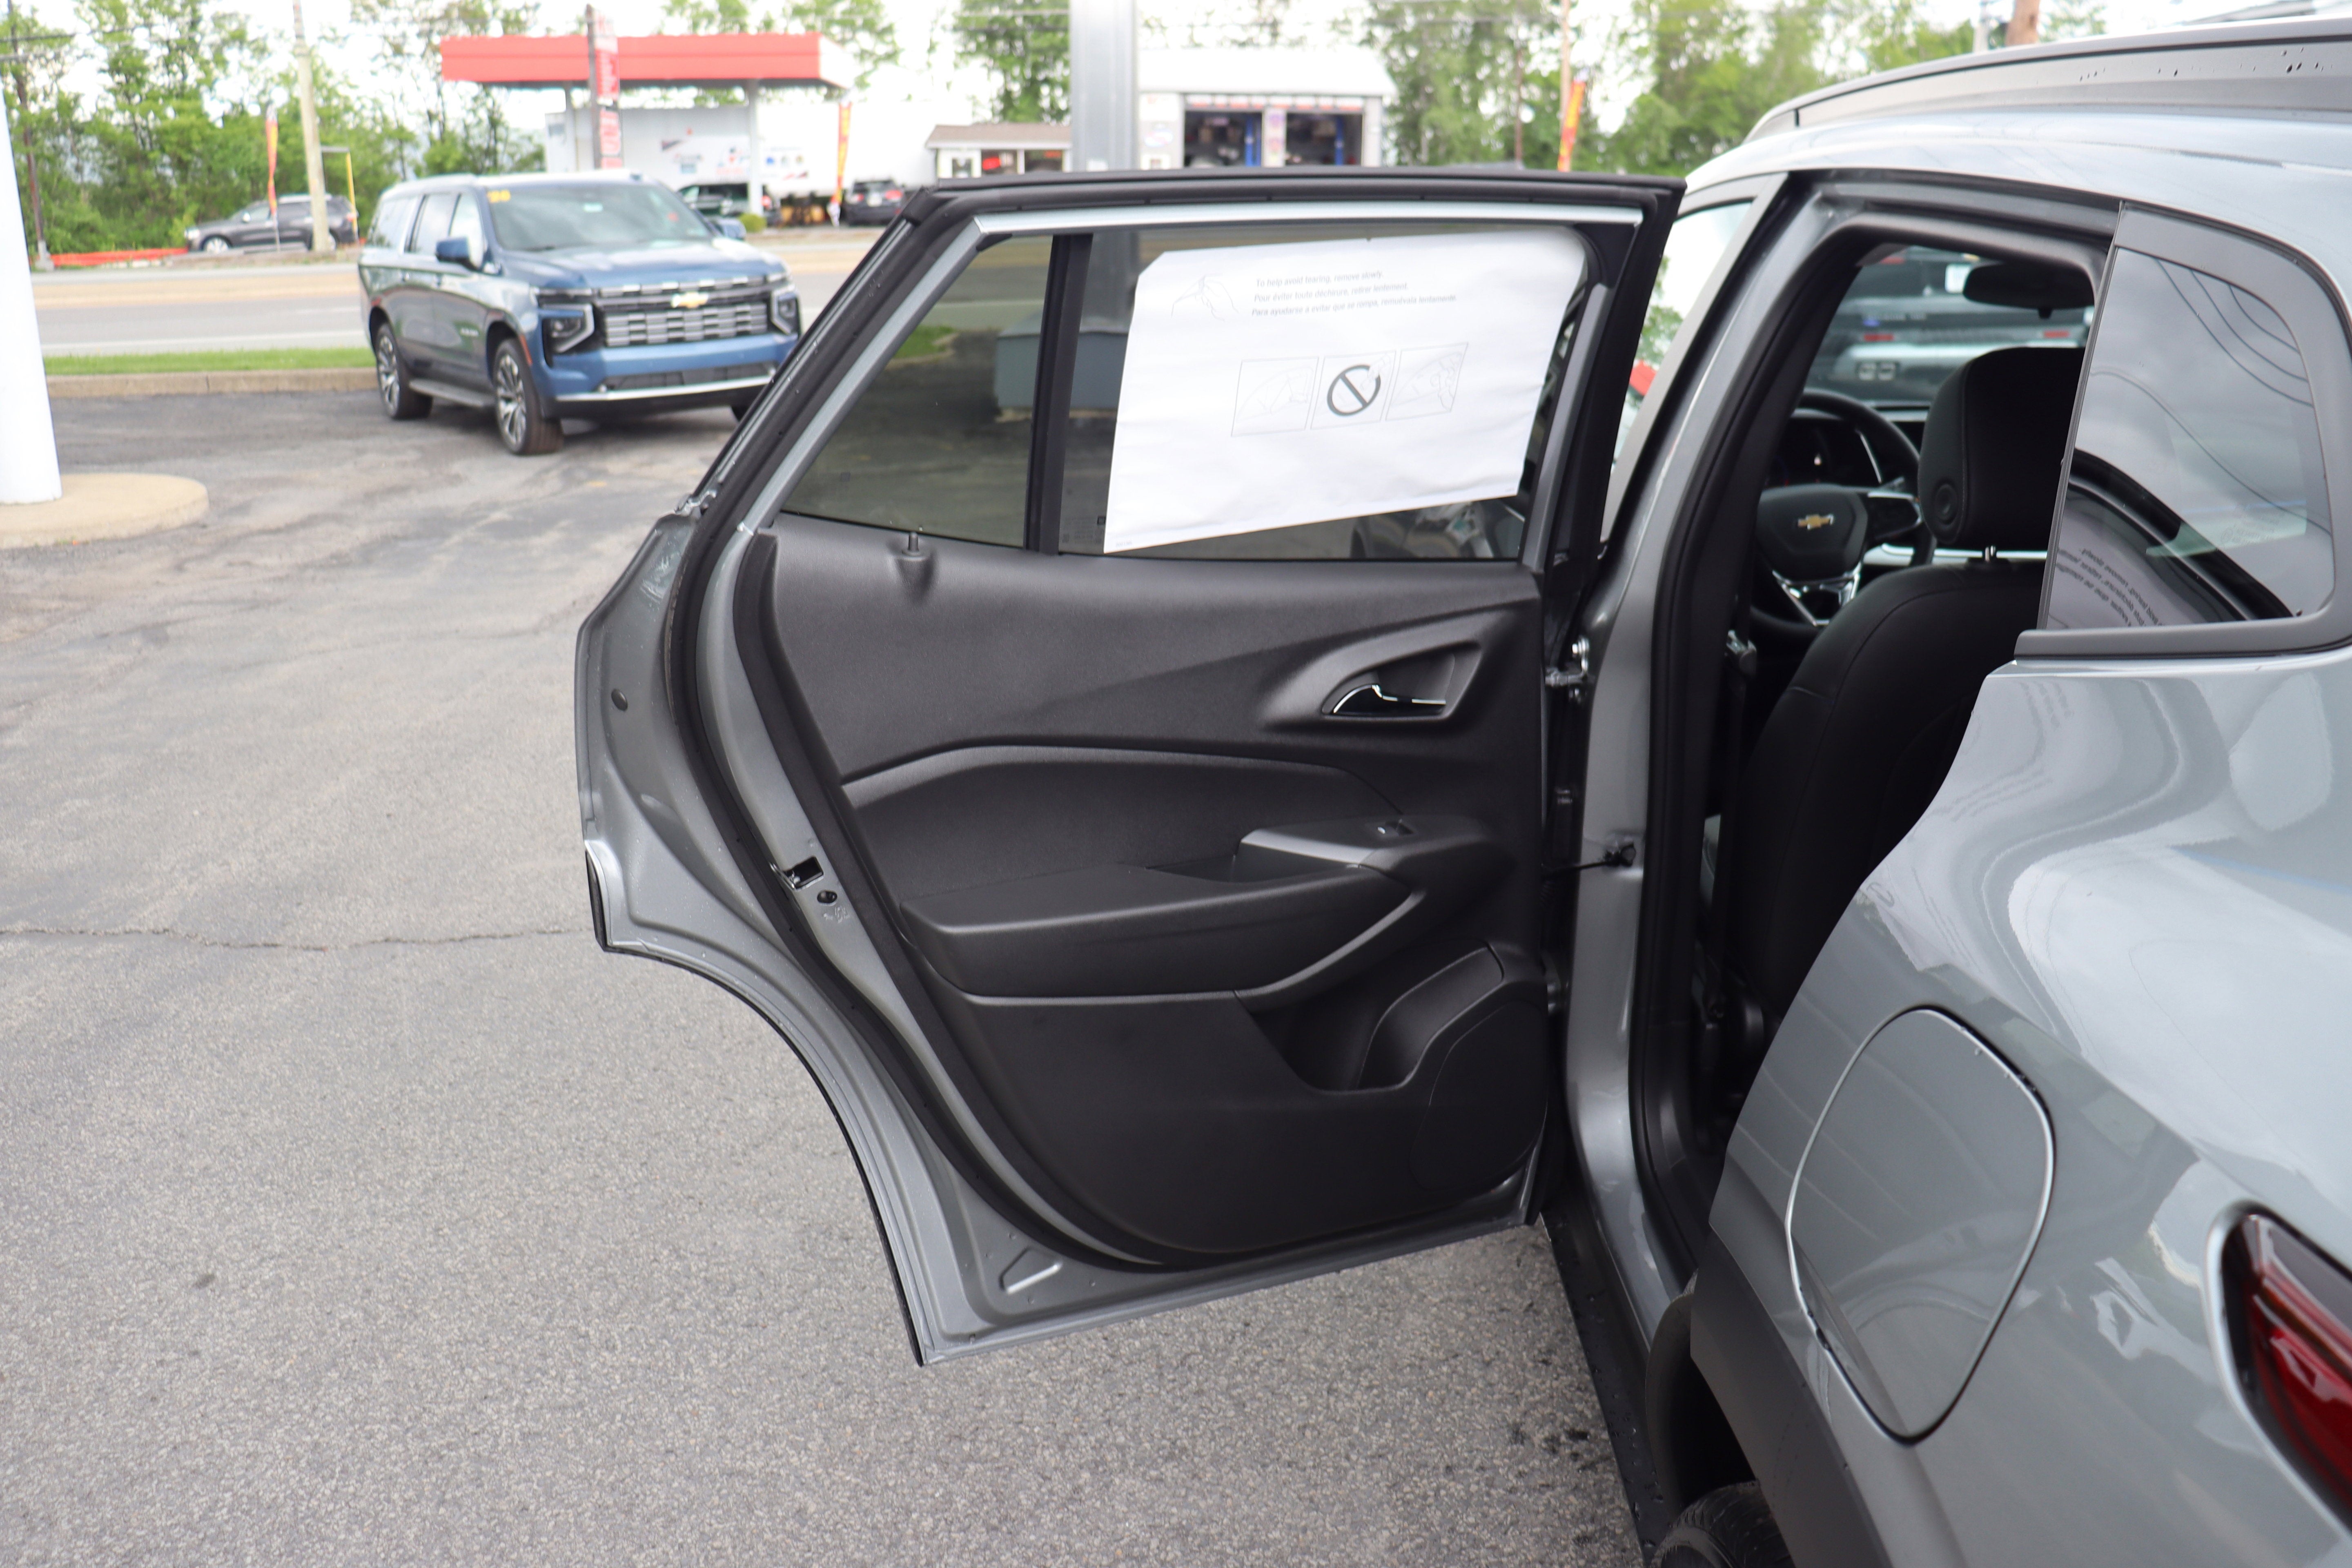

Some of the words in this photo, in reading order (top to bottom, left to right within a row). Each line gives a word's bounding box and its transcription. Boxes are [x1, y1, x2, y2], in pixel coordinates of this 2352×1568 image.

[1256, 278, 1265, 287] To
[1267, 278, 1282, 288] help
[1284, 276, 1303, 286] avoid
[1305, 274, 1332, 285] tearing,
[1334, 273, 1360, 282] remove
[1361, 270, 1384, 280] slowly.
[1254, 293, 1271, 302] Pour
[1273, 292, 1293, 302] éviter
[1295, 290, 1313, 300] toute
[1315, 288, 1349, 297] déchirure,
[1351, 286, 1372, 295] retirer
[1373, 283, 1409, 292] lentement.
[1252, 307, 1269, 317] Para
[1270, 306, 1303, 317] ayudarse
[1311, 304, 1331, 314] evitar
[1333, 303, 1345, 313] que
[1347, 301, 1355, 310] se
[1356, 299, 1379, 310] rompa,
